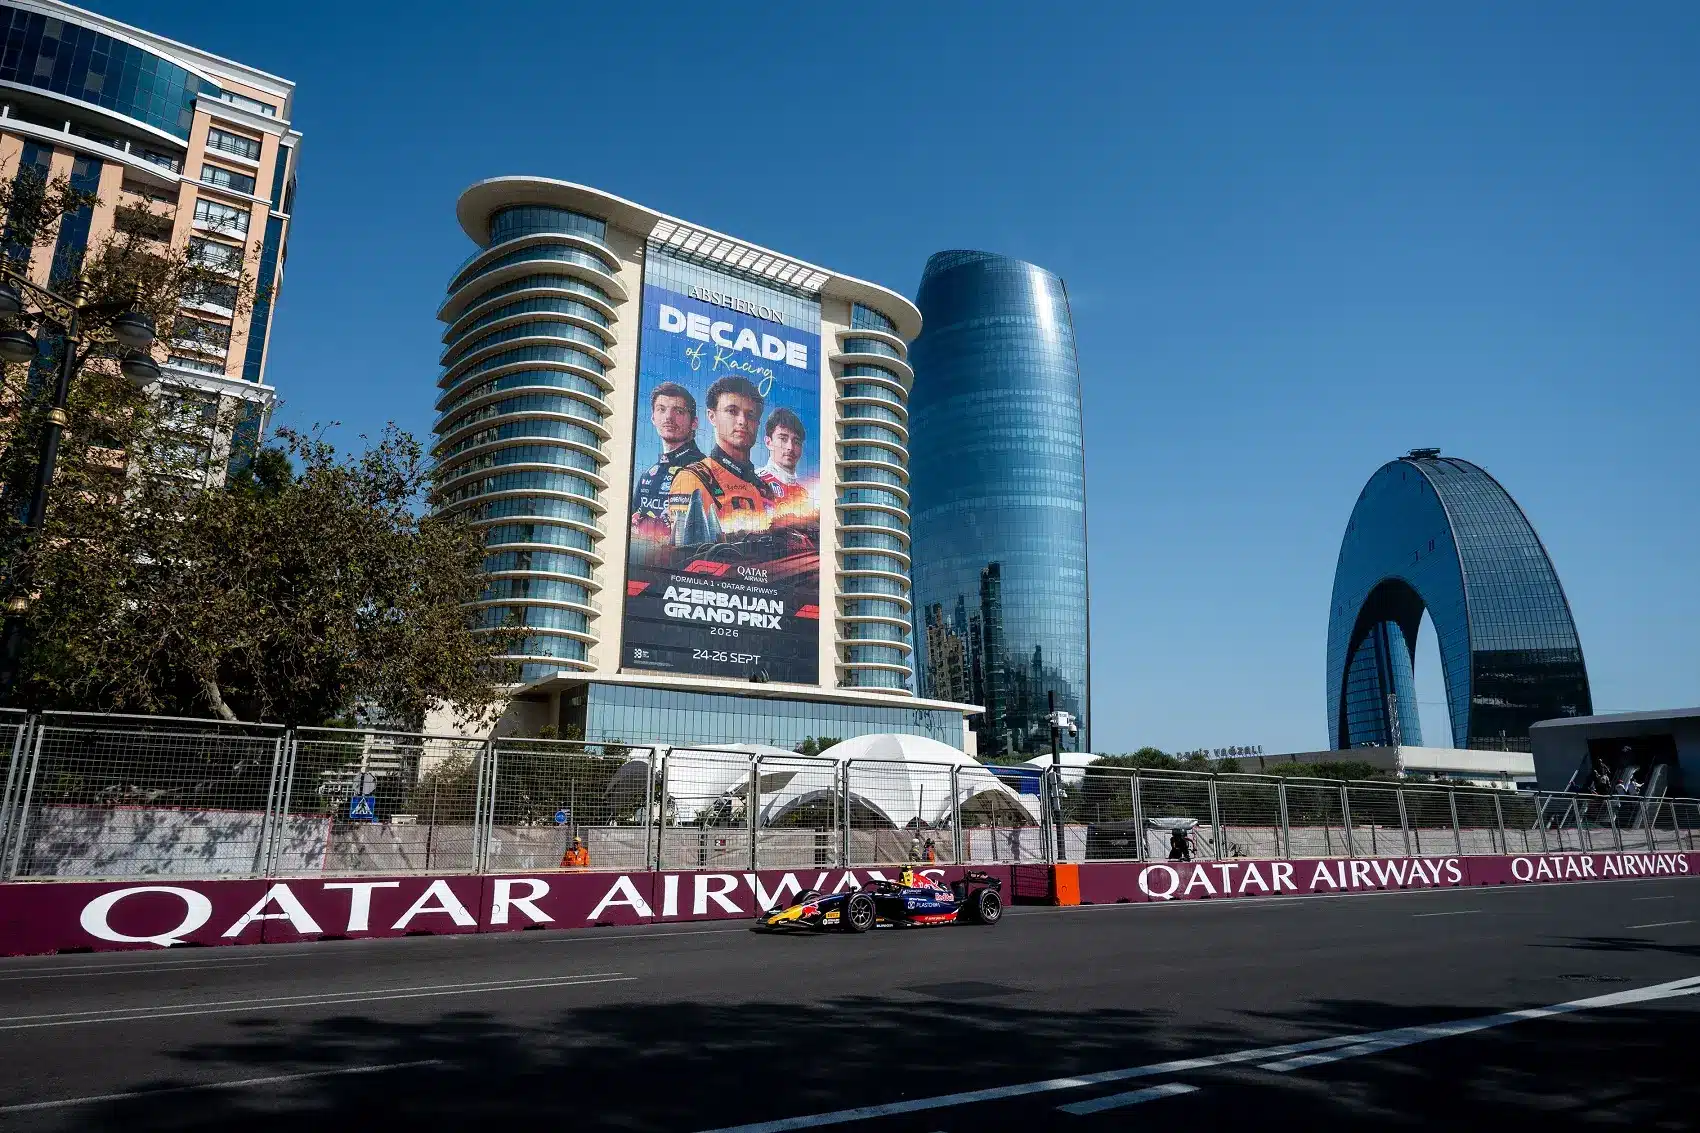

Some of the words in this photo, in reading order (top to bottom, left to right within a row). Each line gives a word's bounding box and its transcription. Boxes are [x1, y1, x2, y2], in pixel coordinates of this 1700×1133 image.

[690, 286, 784, 324] ABSHERON
[659, 303, 808, 370] DECADE
[686, 343, 706, 371] of
[712, 344, 777, 398] Racing
[670, 575, 709, 586] FORMULA
[721, 582, 745, 591] QATAR
[746, 586, 778, 596] AIRWAYS
[737, 566, 768, 578] QATAR
[744, 575, 768, 584] AIRWAYS
[662, 586, 784, 615] AZERBAIJAN
[663, 602, 735, 624] GRAND
[737, 610, 782, 631] PRIX
[710, 627, 739, 637] 2026
[692, 649, 728, 663] 24-26
[729, 652, 761, 665] SEPT
[1138, 862, 1298, 899] QATAR
[1309, 858, 1462, 889] AIRWAYS
[1511, 856, 1597, 883] QATAR
[1603, 853, 1689, 876] AIRWAYS
[79, 878, 555, 947] QATAR
